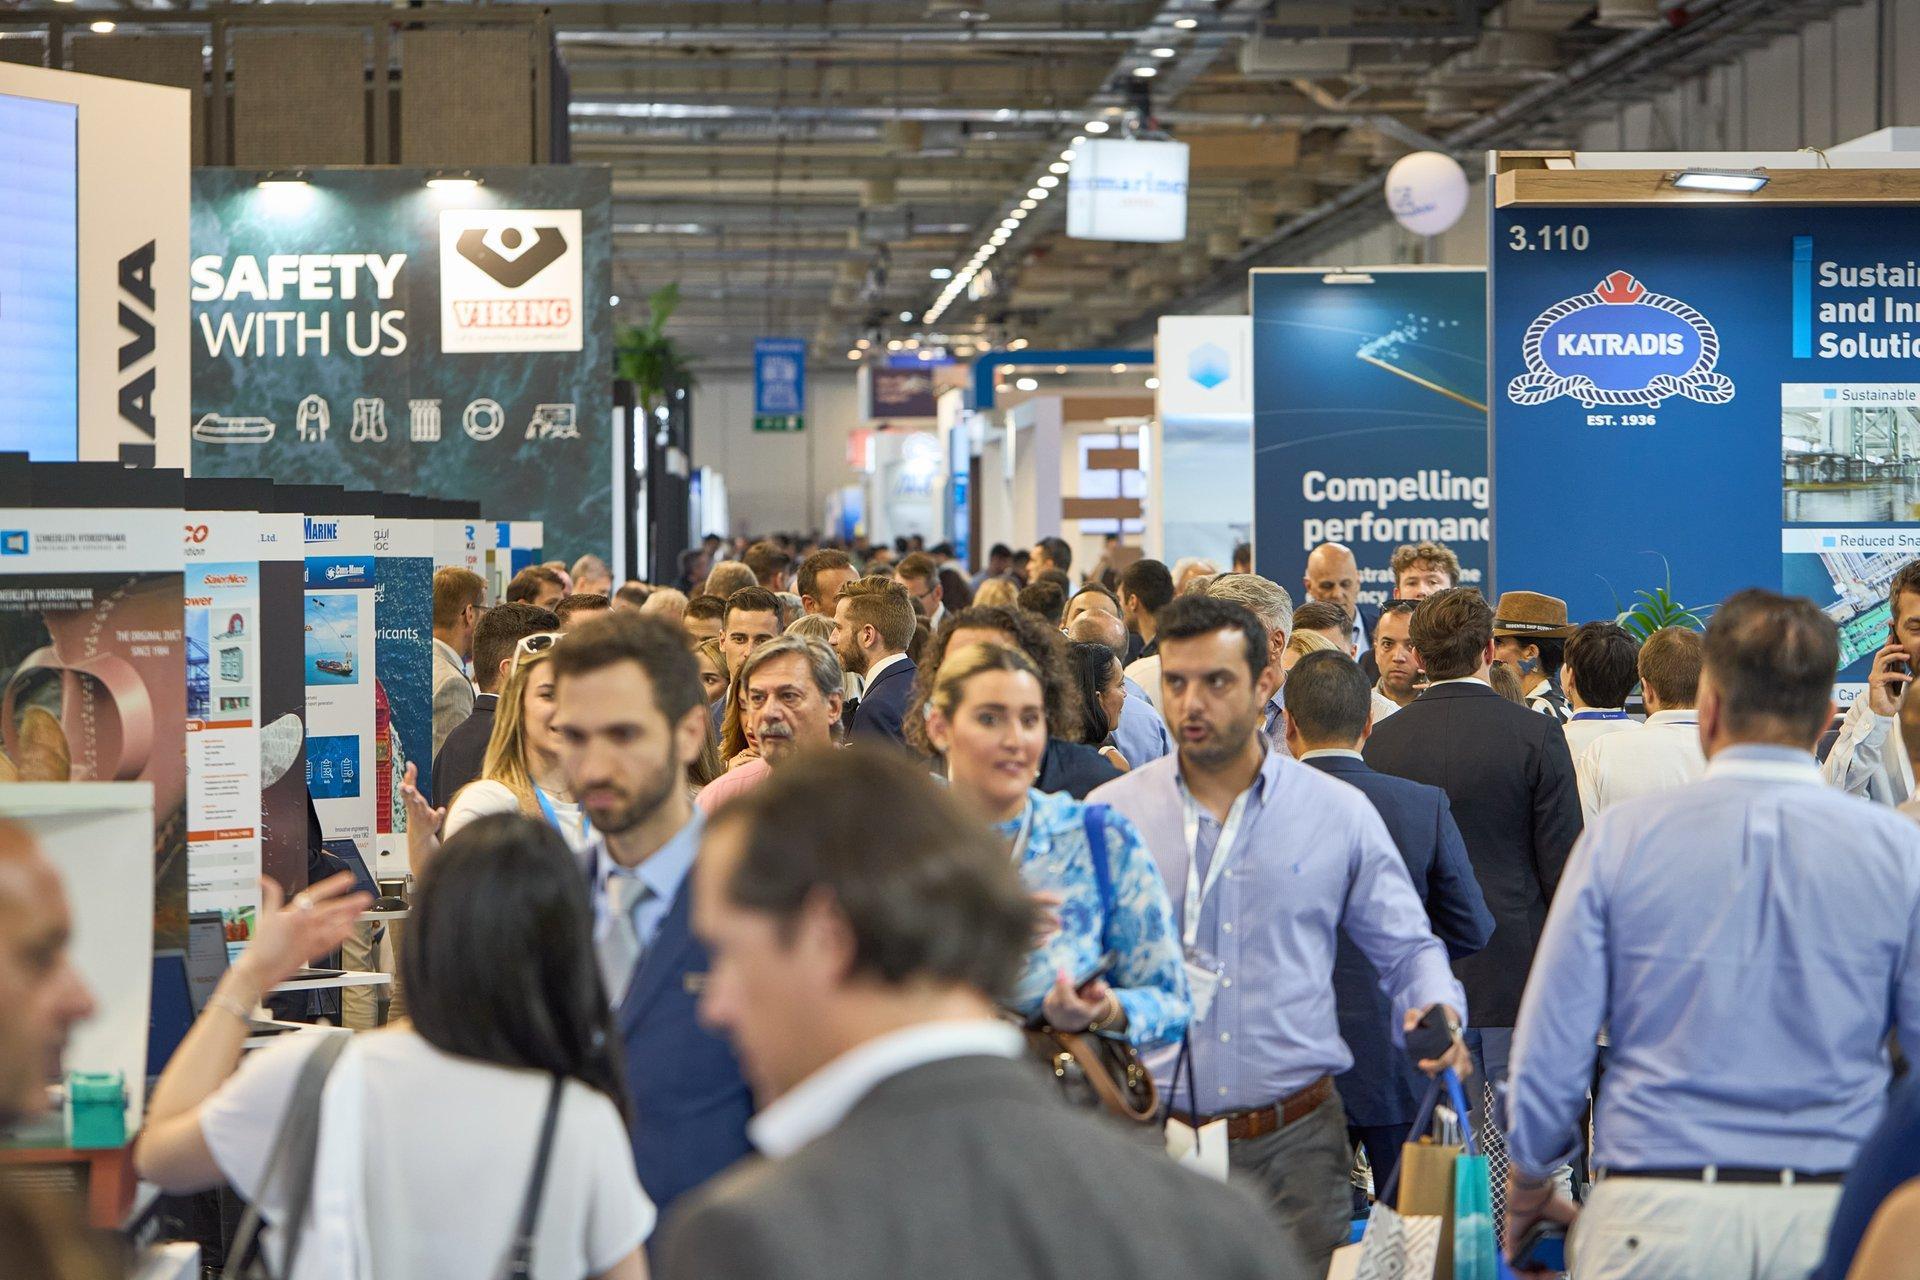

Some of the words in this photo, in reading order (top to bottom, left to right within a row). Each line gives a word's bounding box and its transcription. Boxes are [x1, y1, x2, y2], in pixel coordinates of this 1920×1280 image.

[1509, 225, 1590, 251] 3.110
[190, 253, 408, 302] SAFETY
[1818, 261, 1920, 288] Sustai
[453, 299, 572, 328] VIKING
[1818, 297, 1876, 323] and
[1885, 297, 1920, 323] In
[200, 311, 331, 357] WITH
[346, 311, 408, 357] US
[1557, 333, 1684, 356] KATRADIS
[118, 239, 156, 469] AVA
[1842, 389, 1916, 402] Sustainable
[1587, 414, 1617, 427] EST.
[1620, 414, 1657, 427] 1936
[1302, 469, 1489, 510] Compelling
[1840, 534, 1895, 547] Reduced
[1898, 534, 1920, 547] Sna
[185, 597, 213, 606] ower
